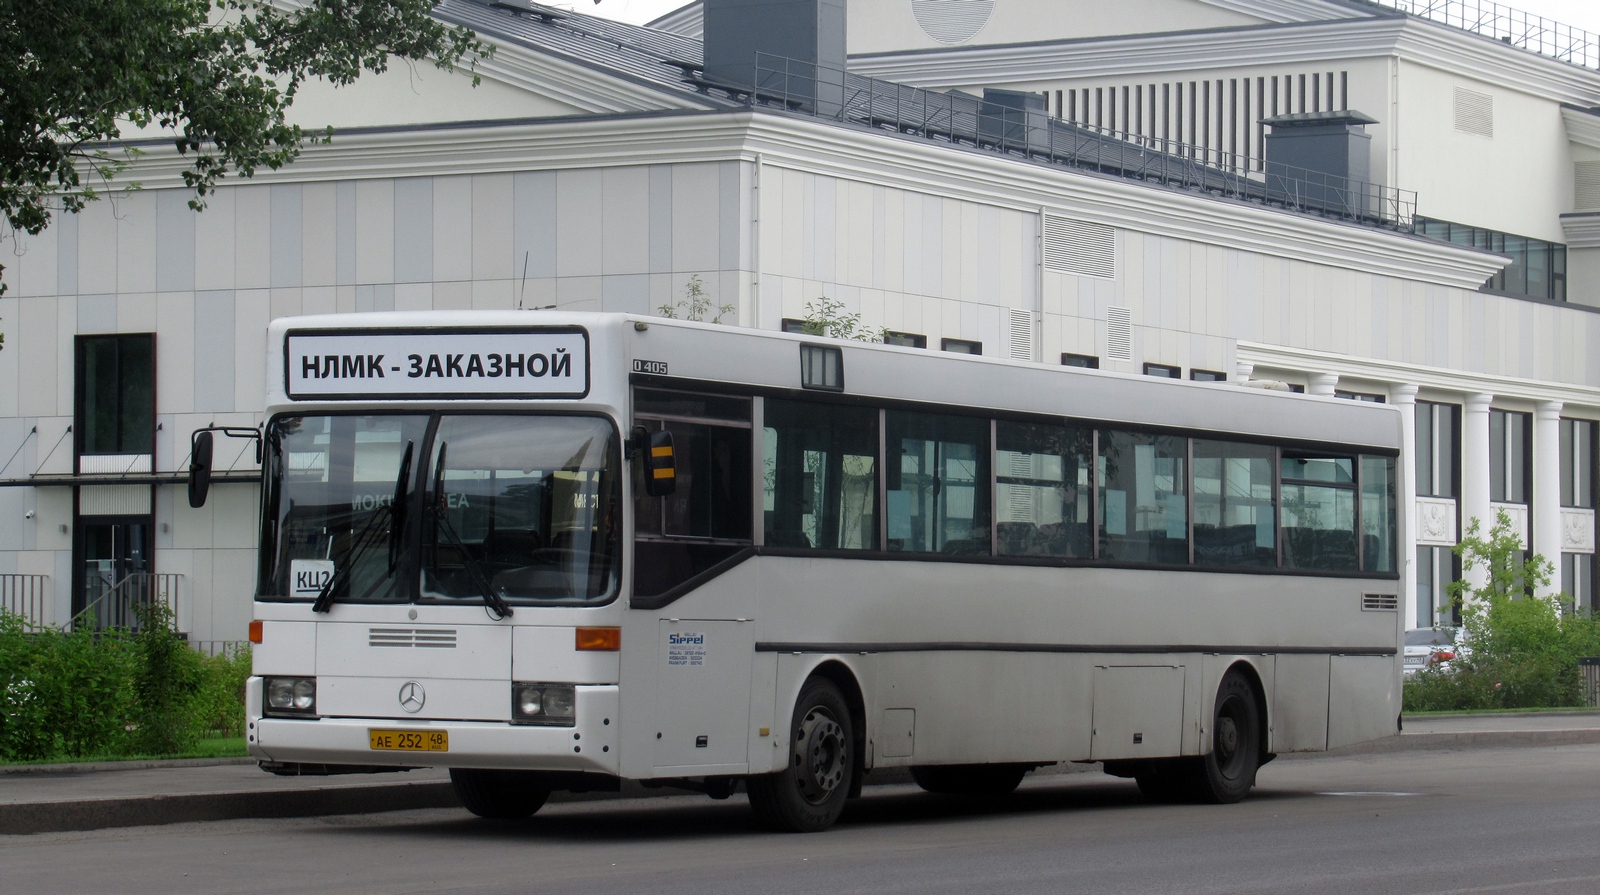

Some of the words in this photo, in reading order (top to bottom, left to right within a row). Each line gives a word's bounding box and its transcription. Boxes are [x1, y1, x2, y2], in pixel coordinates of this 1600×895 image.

[302, 355, 385, 379] НЛМК
[407, 347, 571, 378] ЗАКАЗНОЙ
[643, 361, 667, 374] 405
[669, 632, 704, 645] Sippel
[376, 736, 392, 748] АЕ
[398, 733, 422, 748] 252
[430, 733, 443, 745] 48
